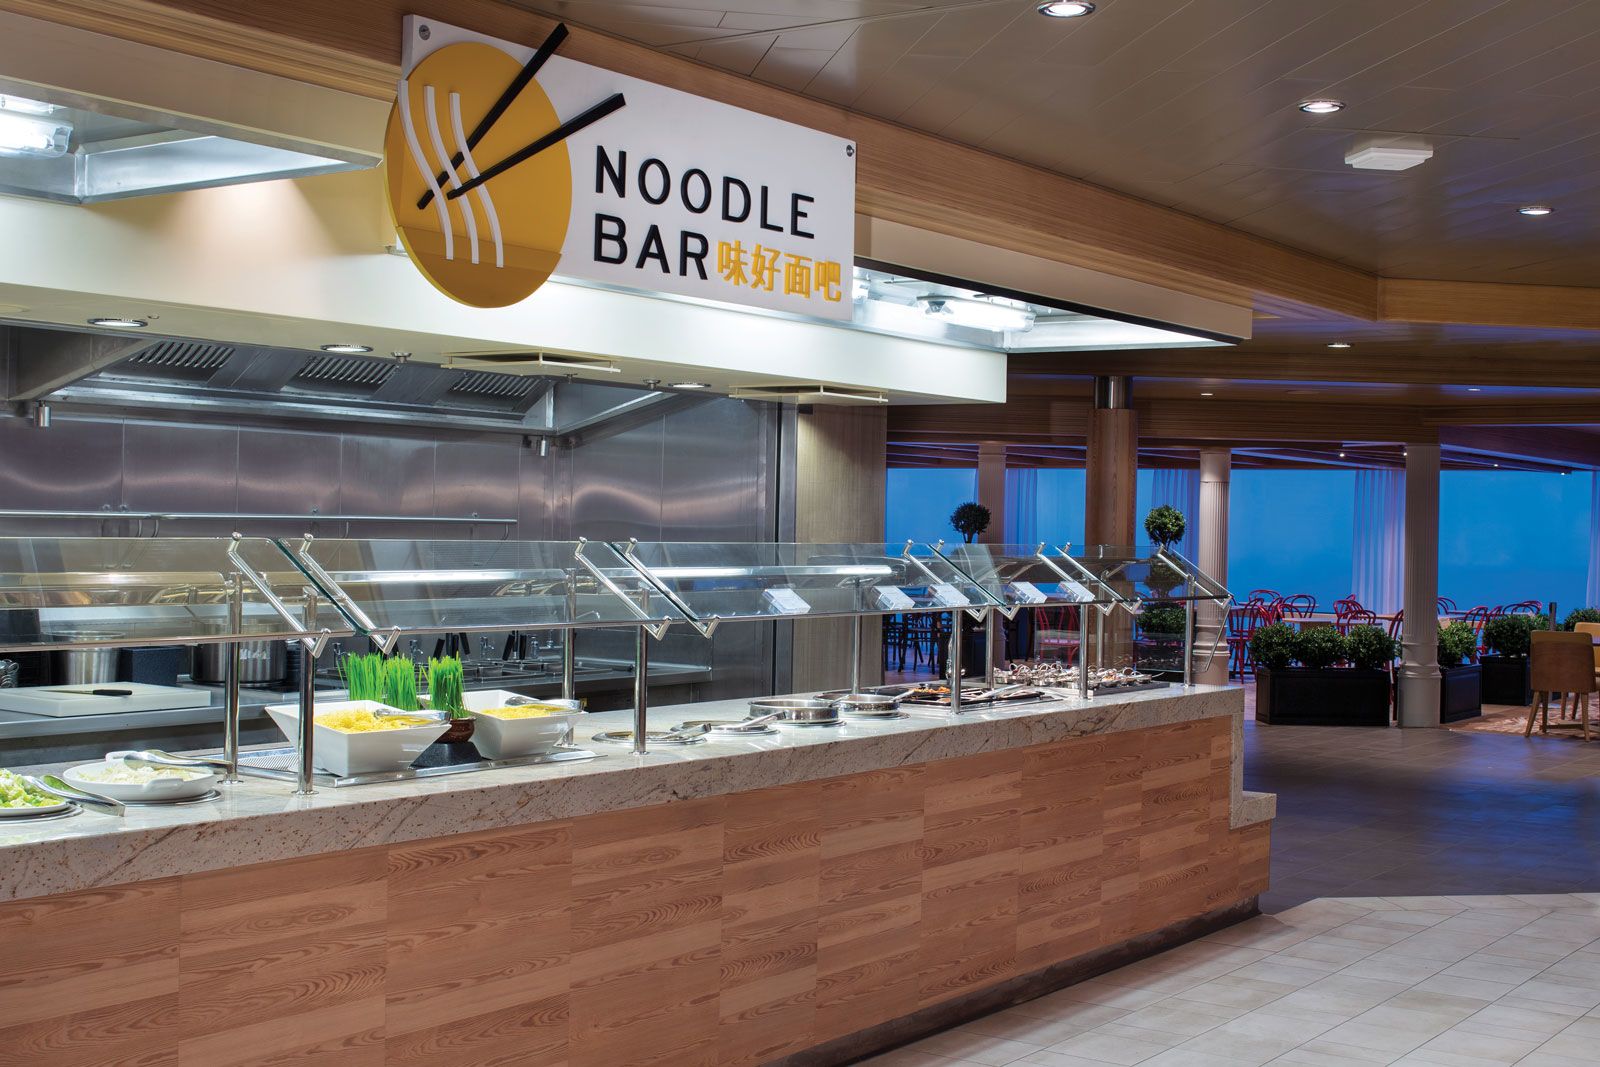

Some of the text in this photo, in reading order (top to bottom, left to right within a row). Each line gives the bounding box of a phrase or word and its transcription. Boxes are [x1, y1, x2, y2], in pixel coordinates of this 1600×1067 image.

[595, 144, 815, 239] NOODLE
[594, 212, 709, 281] BAR
[717, 239, 842, 302] 味好面吧
